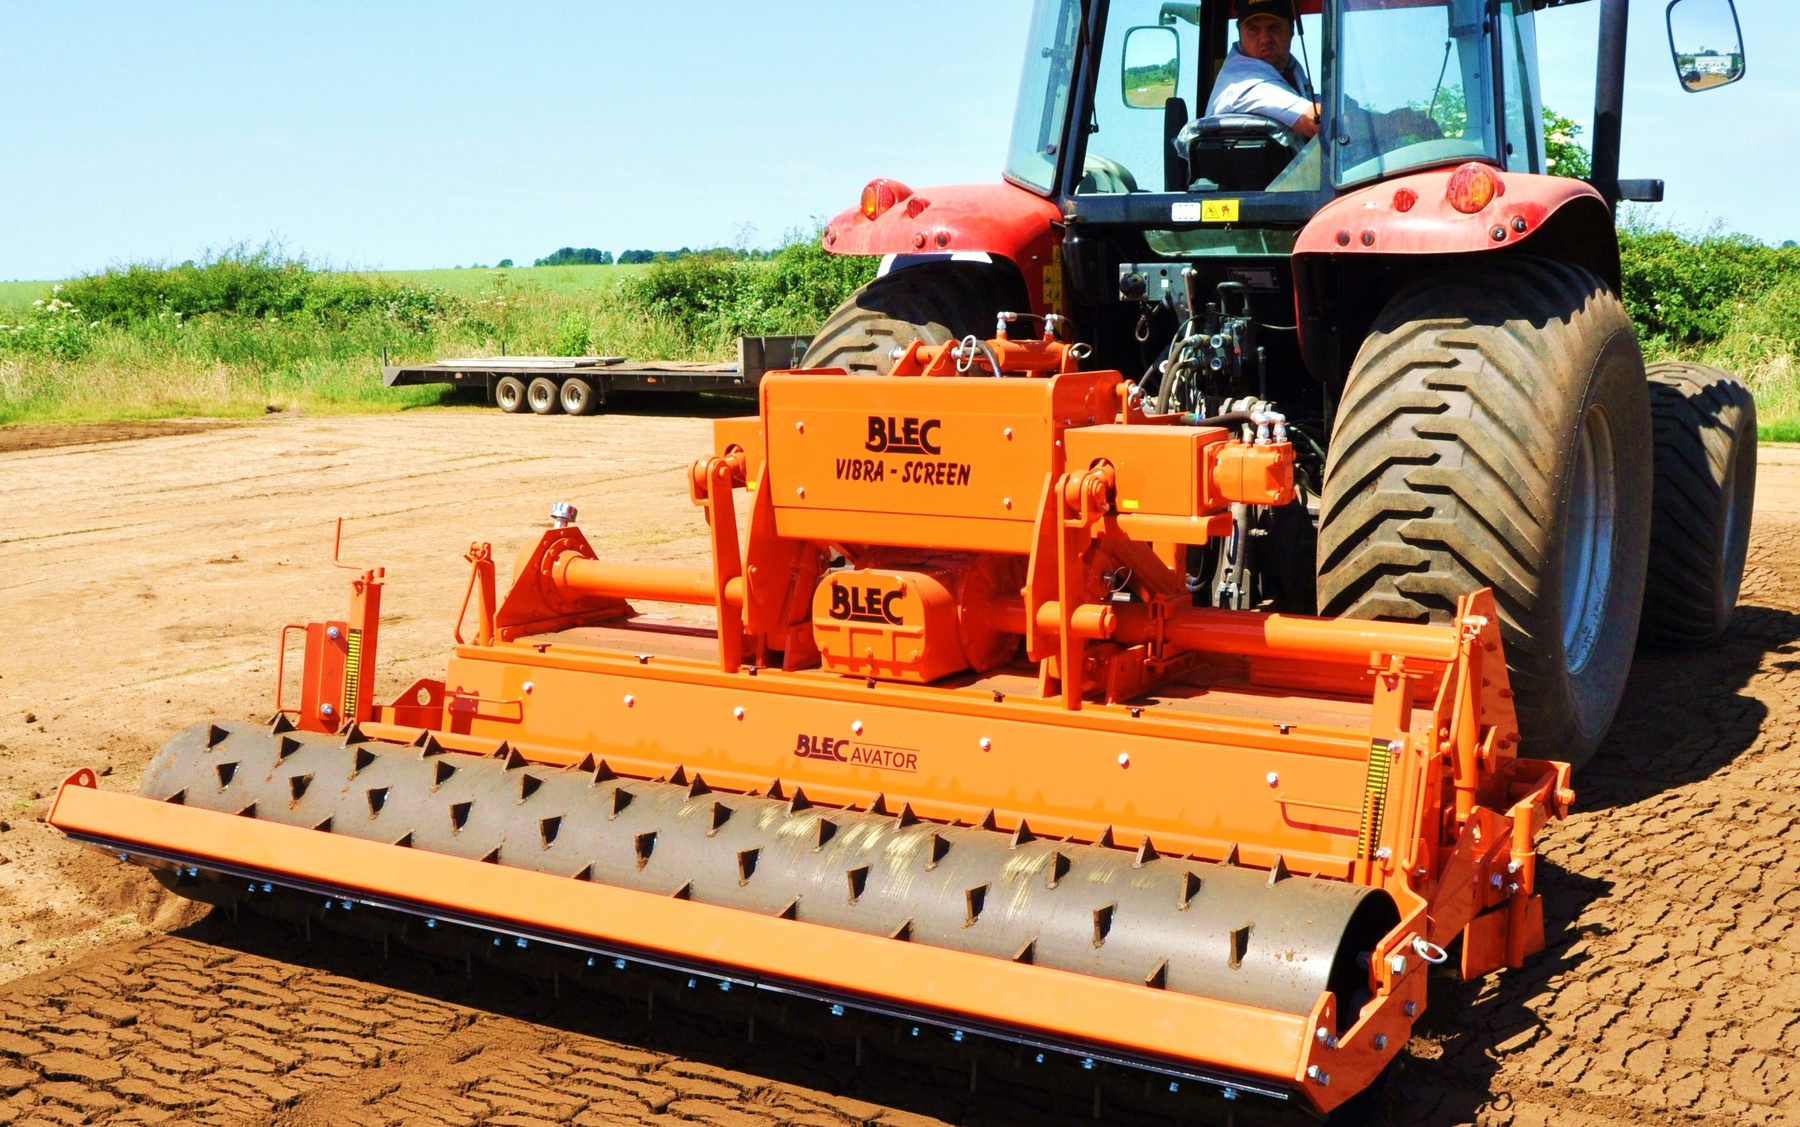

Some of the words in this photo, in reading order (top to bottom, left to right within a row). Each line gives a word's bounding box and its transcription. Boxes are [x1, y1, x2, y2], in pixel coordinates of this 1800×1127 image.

[865, 416, 941, 455] BLEC
[836, 458, 884, 482] VIBRA
[902, 461, 971, 487] SCREEN
[829, 584, 904, 625] BLEC
